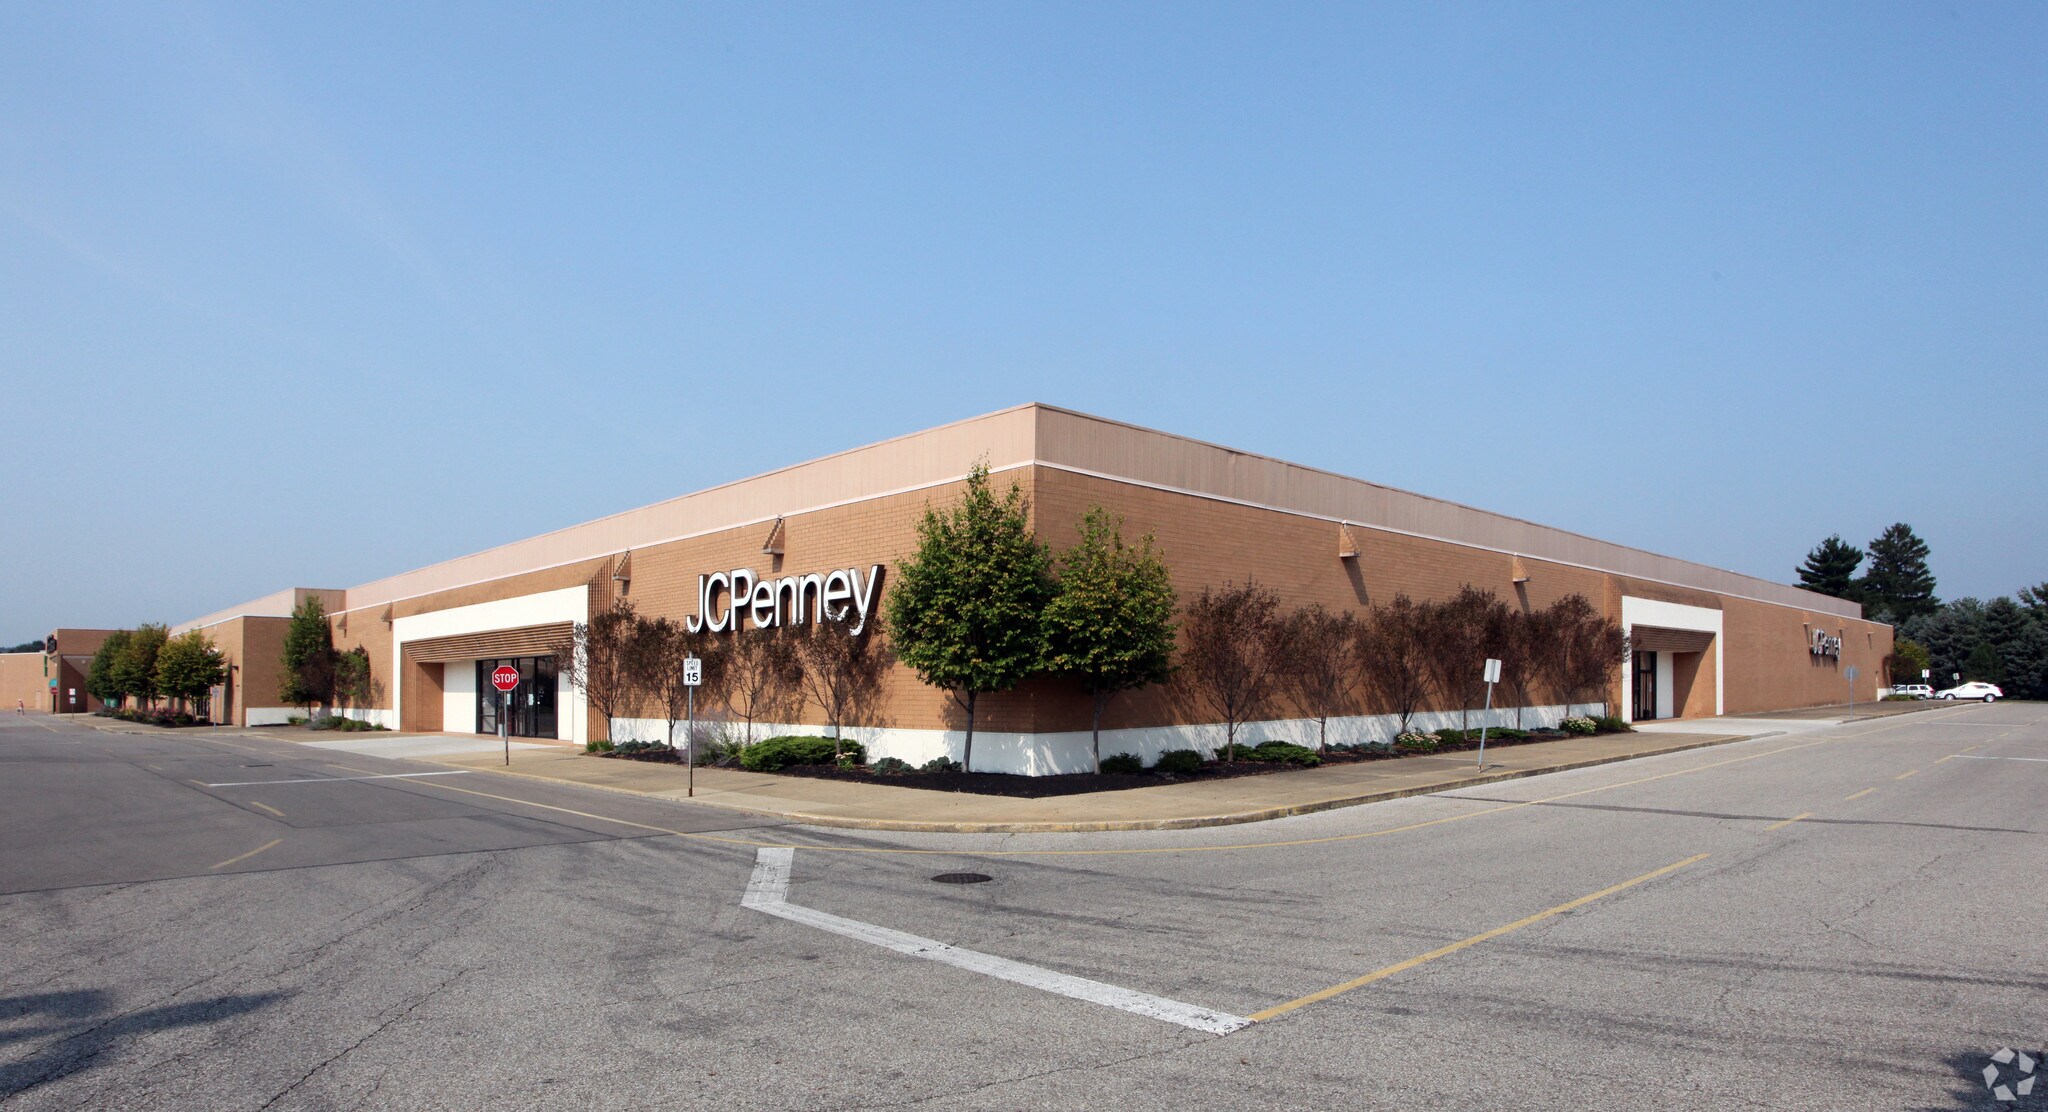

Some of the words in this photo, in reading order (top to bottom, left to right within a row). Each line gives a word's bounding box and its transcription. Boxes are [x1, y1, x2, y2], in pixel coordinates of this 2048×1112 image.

[686, 564, 882, 636] JCPenney
[494, 673, 517, 683] STOP
[686, 672, 699, 682] 15
